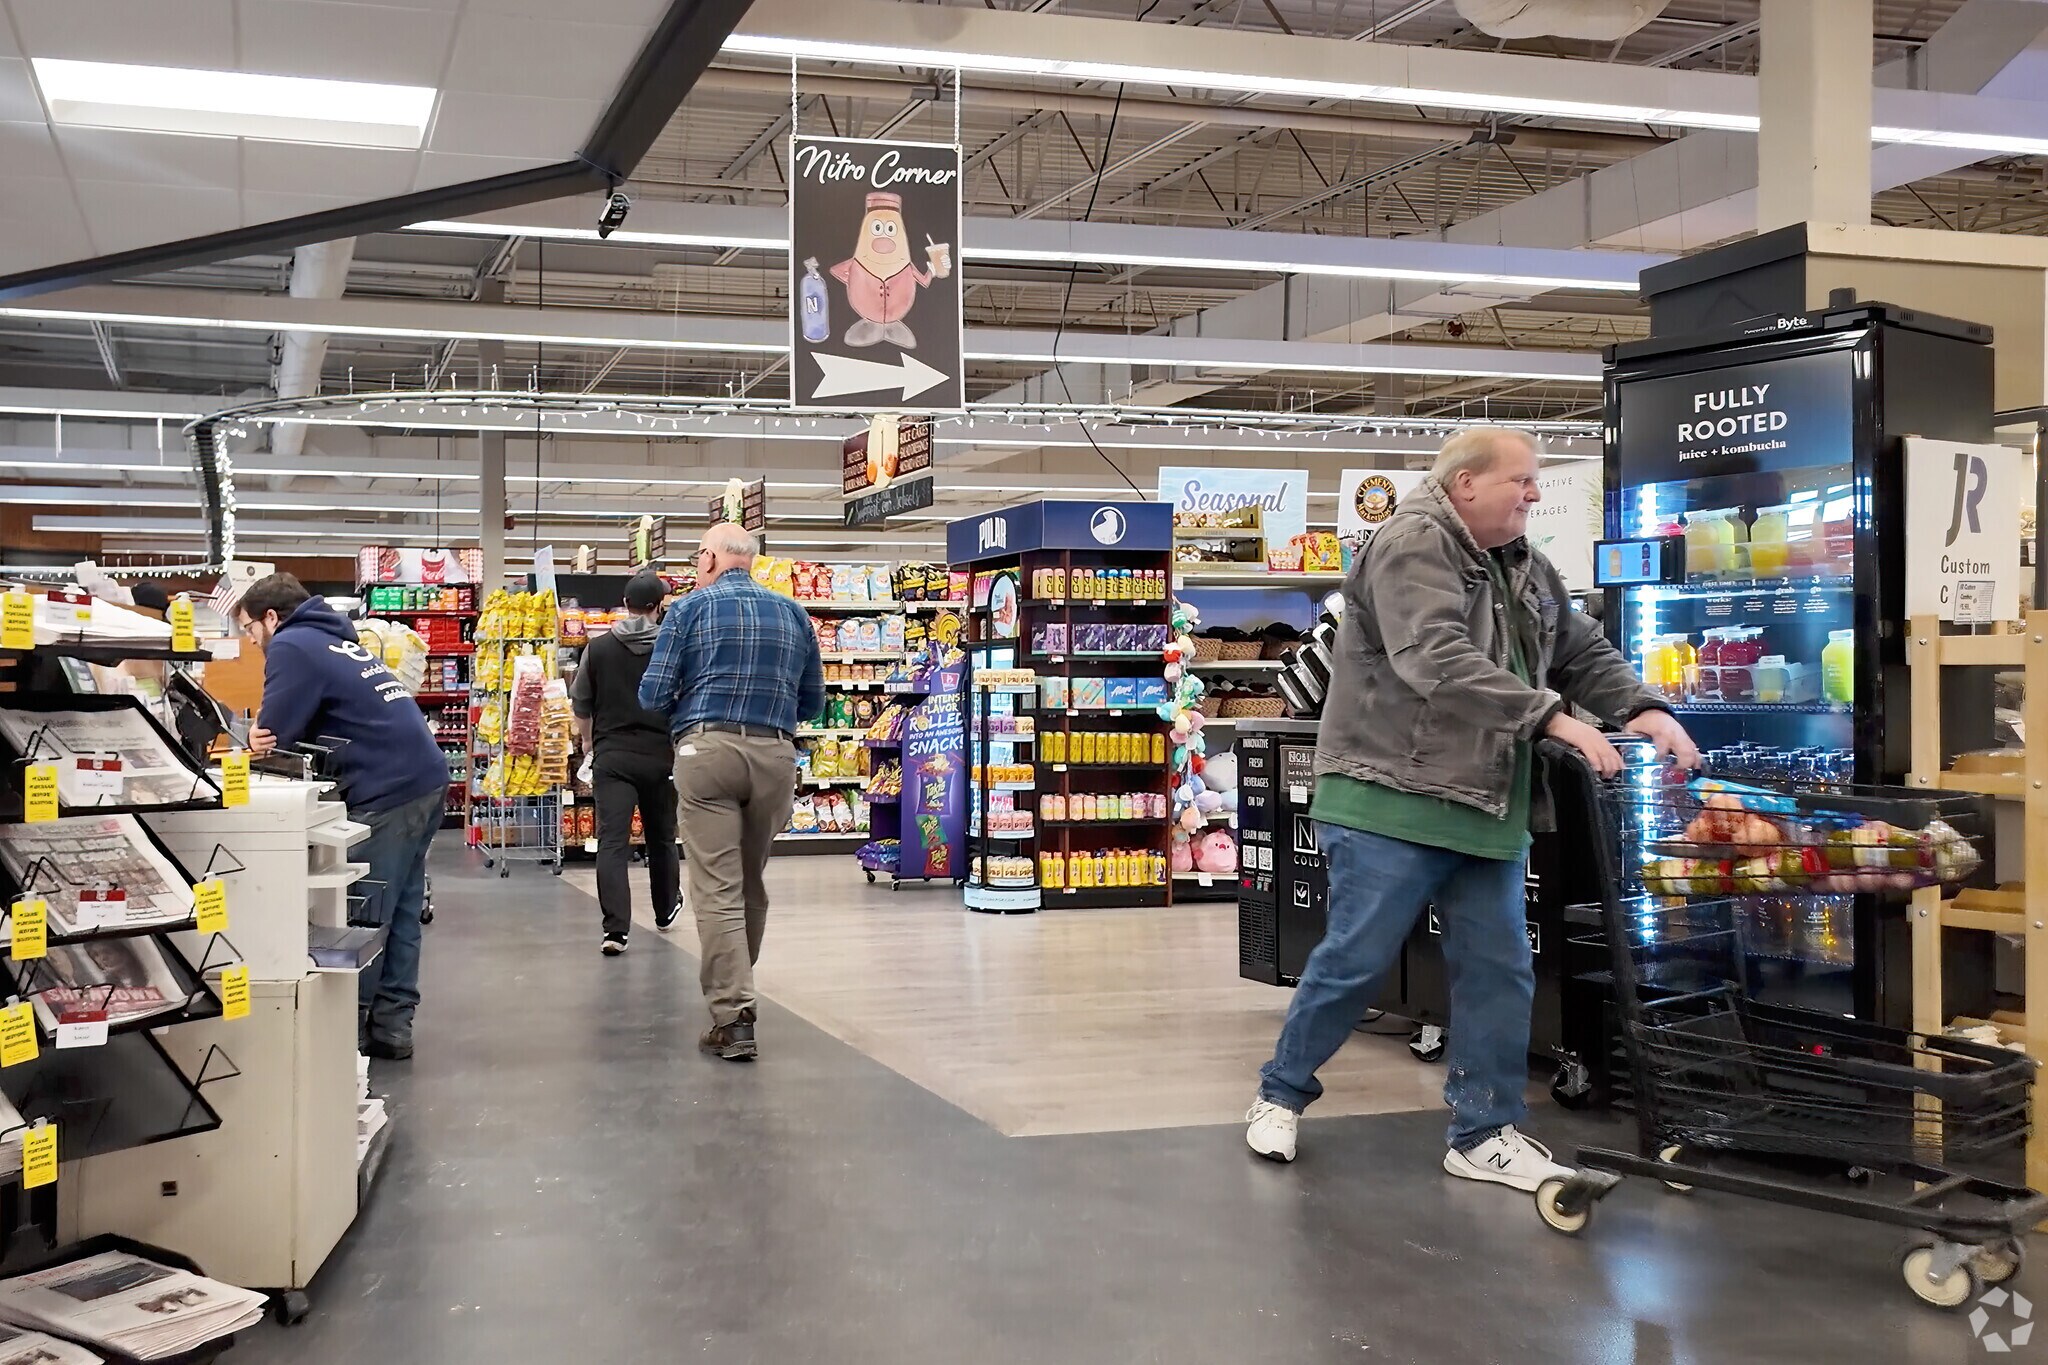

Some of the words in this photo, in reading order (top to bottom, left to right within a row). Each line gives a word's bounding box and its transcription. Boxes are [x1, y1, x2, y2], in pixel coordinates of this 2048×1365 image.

[795, 145, 866, 185] Nitro
[870, 150, 957, 189] Corner
[1777, 316, 1808, 331] Byte
[1694, 383, 1770, 414] FULLY
[1678, 411, 1788, 443] ROOTED
[1678, 449, 1708, 463] juice
[1721, 439, 1787, 457] kombucha
[1539, 476, 1573, 489] VATIVE
[1181, 479, 1289, 513] Seasonal
[1944, 453, 1988, 548] JR
[1530, 505, 1568, 519] ERAGES
[978, 516, 1007, 554] POLAR
[1940, 554, 1990, 574] Custom
[1058, 575, 1065, 593] C4
[1072, 575, 1080, 593] C4
[1083, 576, 1091, 593] C4
[1751, 578, 1757, 587] 1
[1781, 576, 1789, 585] 2
[1811, 574, 1820, 584] 3
[922, 703, 958, 716] FLAVOR
[909, 731, 923, 740] INTO
[924, 730, 935, 738] AN
[908, 733, 965, 757] SNACK!
[1242, 738, 1269, 750] INNOVATIVE
[1248, 757, 1264, 769] FRESH
[1243, 776, 1270, 788] BEVERAGES
[1247, 795, 1256, 807] ON
[1256, 796, 1265, 808] TAP
[1242, 828, 1257, 841] LEARN
[1257, 830, 1272, 843] MORE
[1293, 854, 1320, 868] COLD
[1487, 1152, 1513, 1172] N
